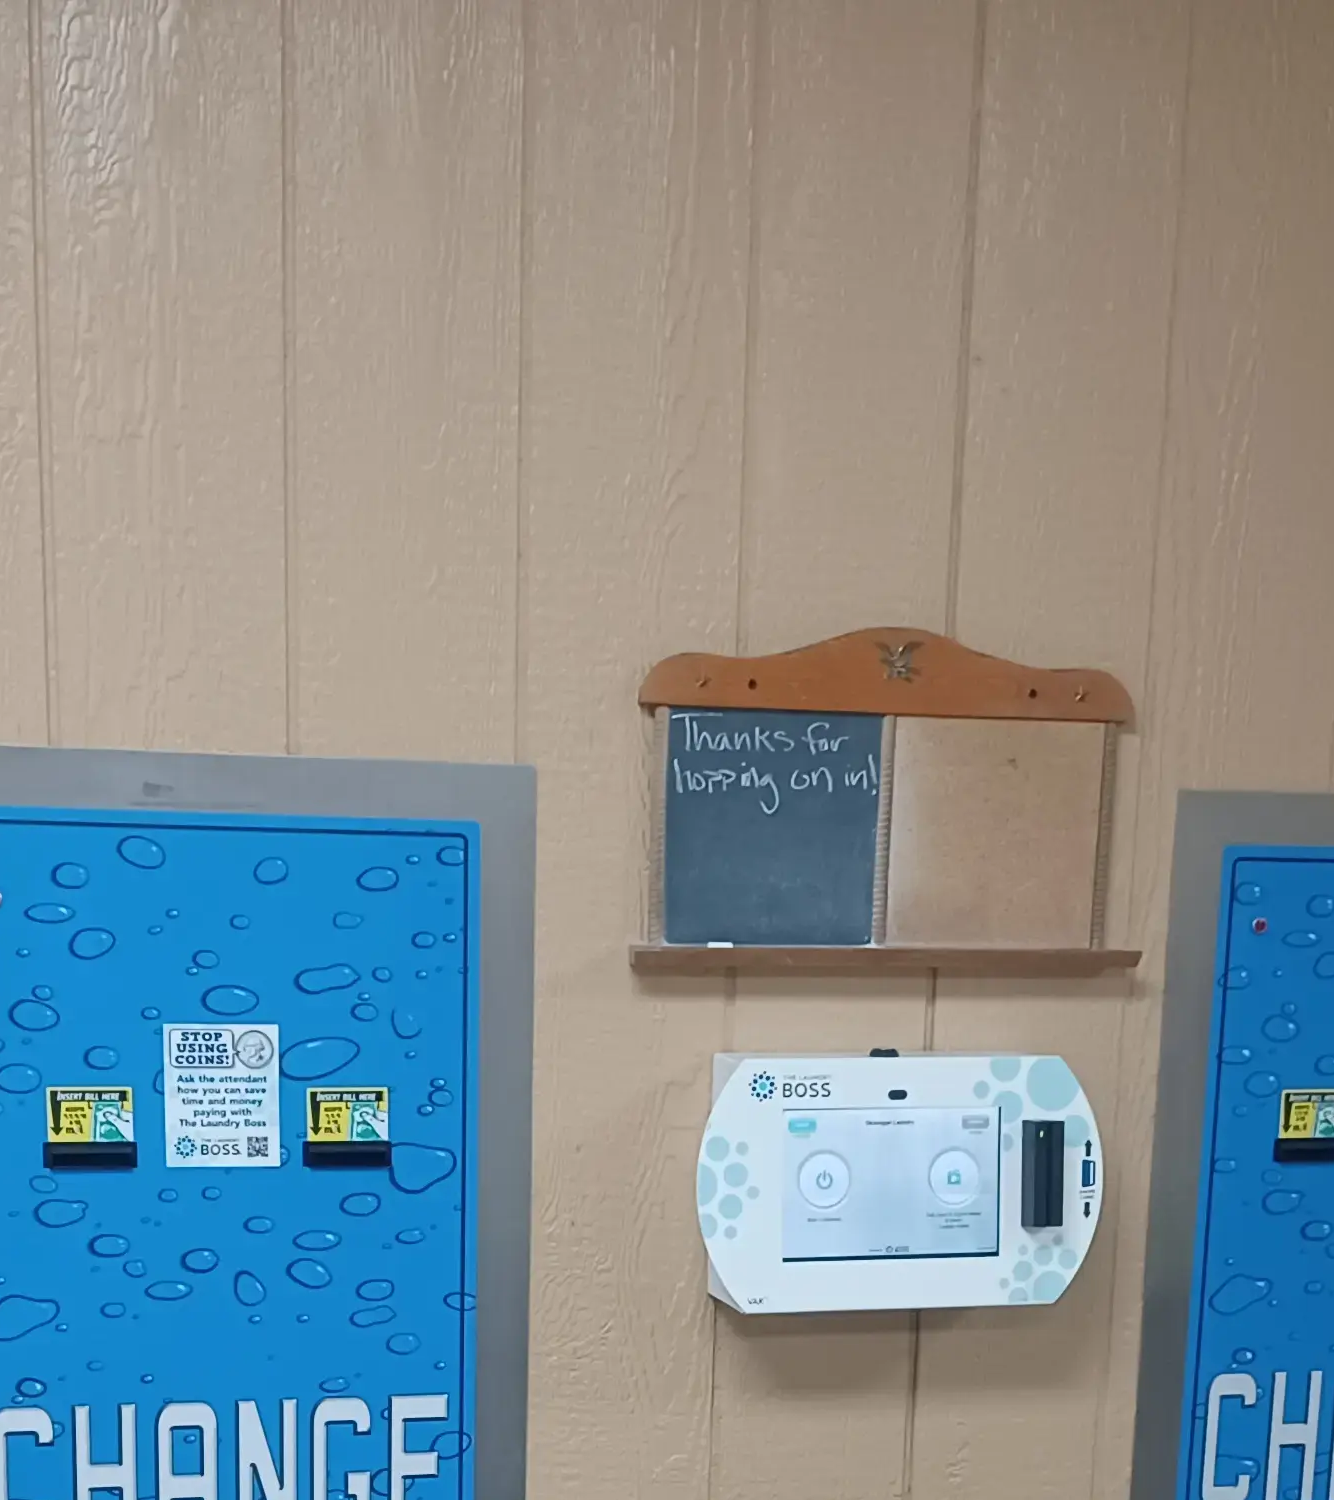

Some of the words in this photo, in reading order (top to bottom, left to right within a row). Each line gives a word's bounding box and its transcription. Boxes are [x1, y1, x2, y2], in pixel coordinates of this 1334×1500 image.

[671, 712, 796, 752] Thanks
[801, 722, 850, 755] for
[673, 758, 780, 814] hopping
[790, 766, 833, 793] on
[845, 754, 878, 796] in!
[180, 1031, 223, 1042] STOP
[176, 1043, 228, 1053] USING
[174, 1055, 230, 1065] COINS!
[177, 1074, 195, 1083] Ask
[199, 1074, 215, 1083] the
[218, 1074, 268, 1083] attendant
[177, 1086, 199, 1094] how
[202, 1087, 221, 1096] you
[782, 1082, 832, 1098] BOSS
[182, 1097, 204, 1105] time
[208, 1097, 226, 1105] and
[229, 1098, 263, 1107] money
[193, 1108, 227, 1118] paying
[230, 1108, 252, 1116] with
[179, 1118, 197, 1127] The
[200, 1118, 241, 1129] Laundry
[244, 1119, 267, 1127] Boss
[200, 1144, 241, 1156] BOSS
